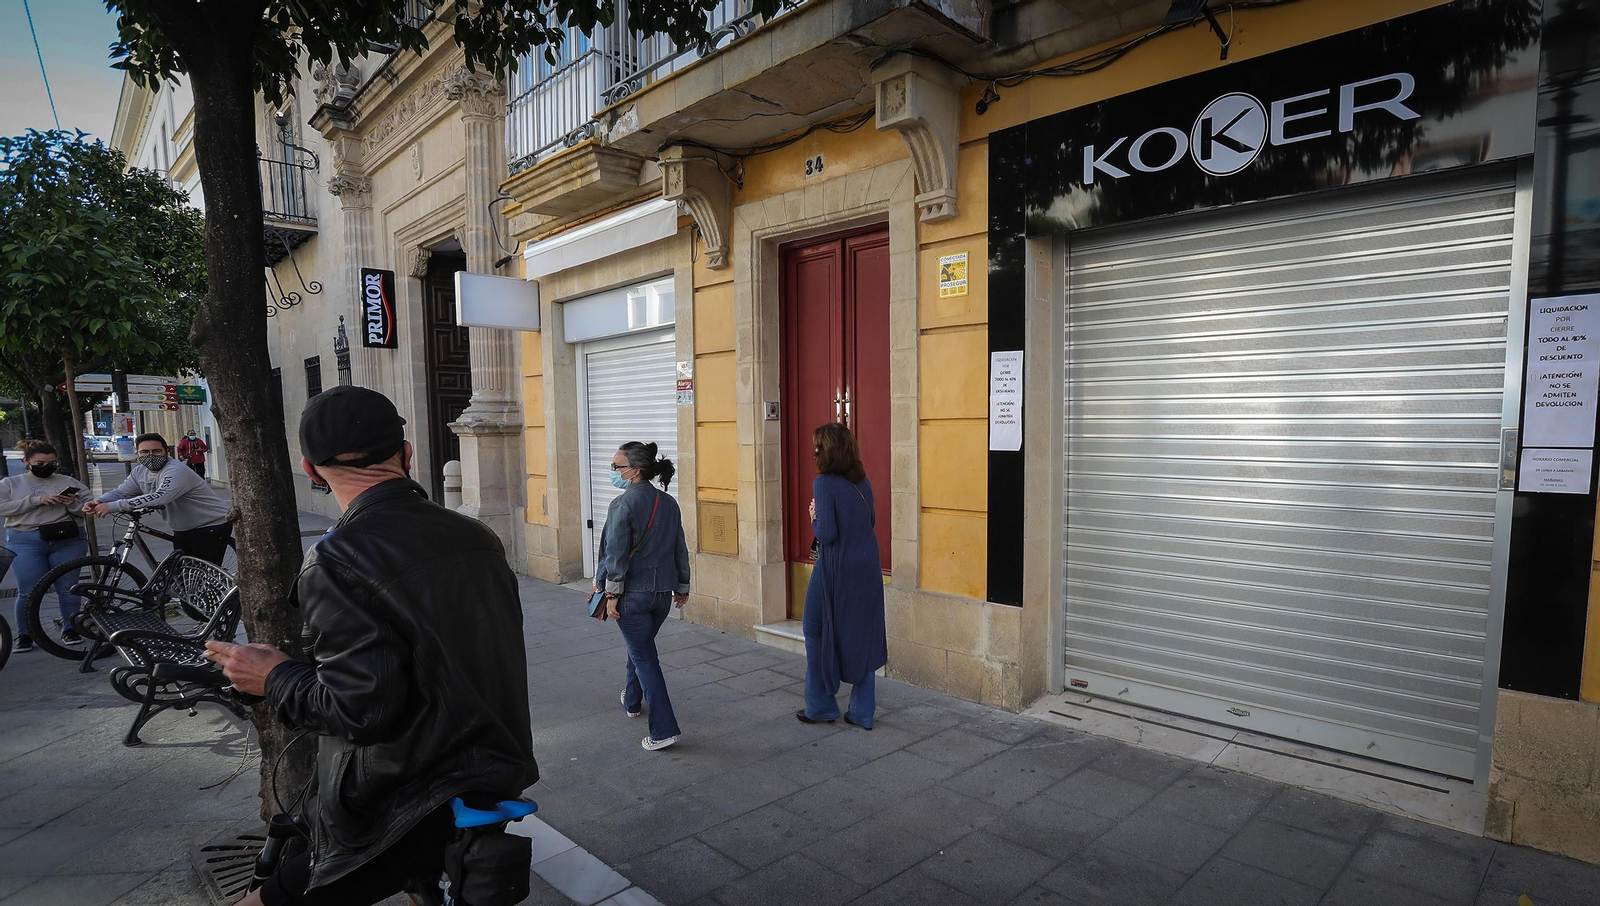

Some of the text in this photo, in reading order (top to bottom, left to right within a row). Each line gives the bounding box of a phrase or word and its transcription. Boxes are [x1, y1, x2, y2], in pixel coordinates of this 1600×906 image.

[1084, 73, 1421, 185] KOKER
[806, 156, 823, 175] 34
[365, 273, 384, 345] PRIMOR
